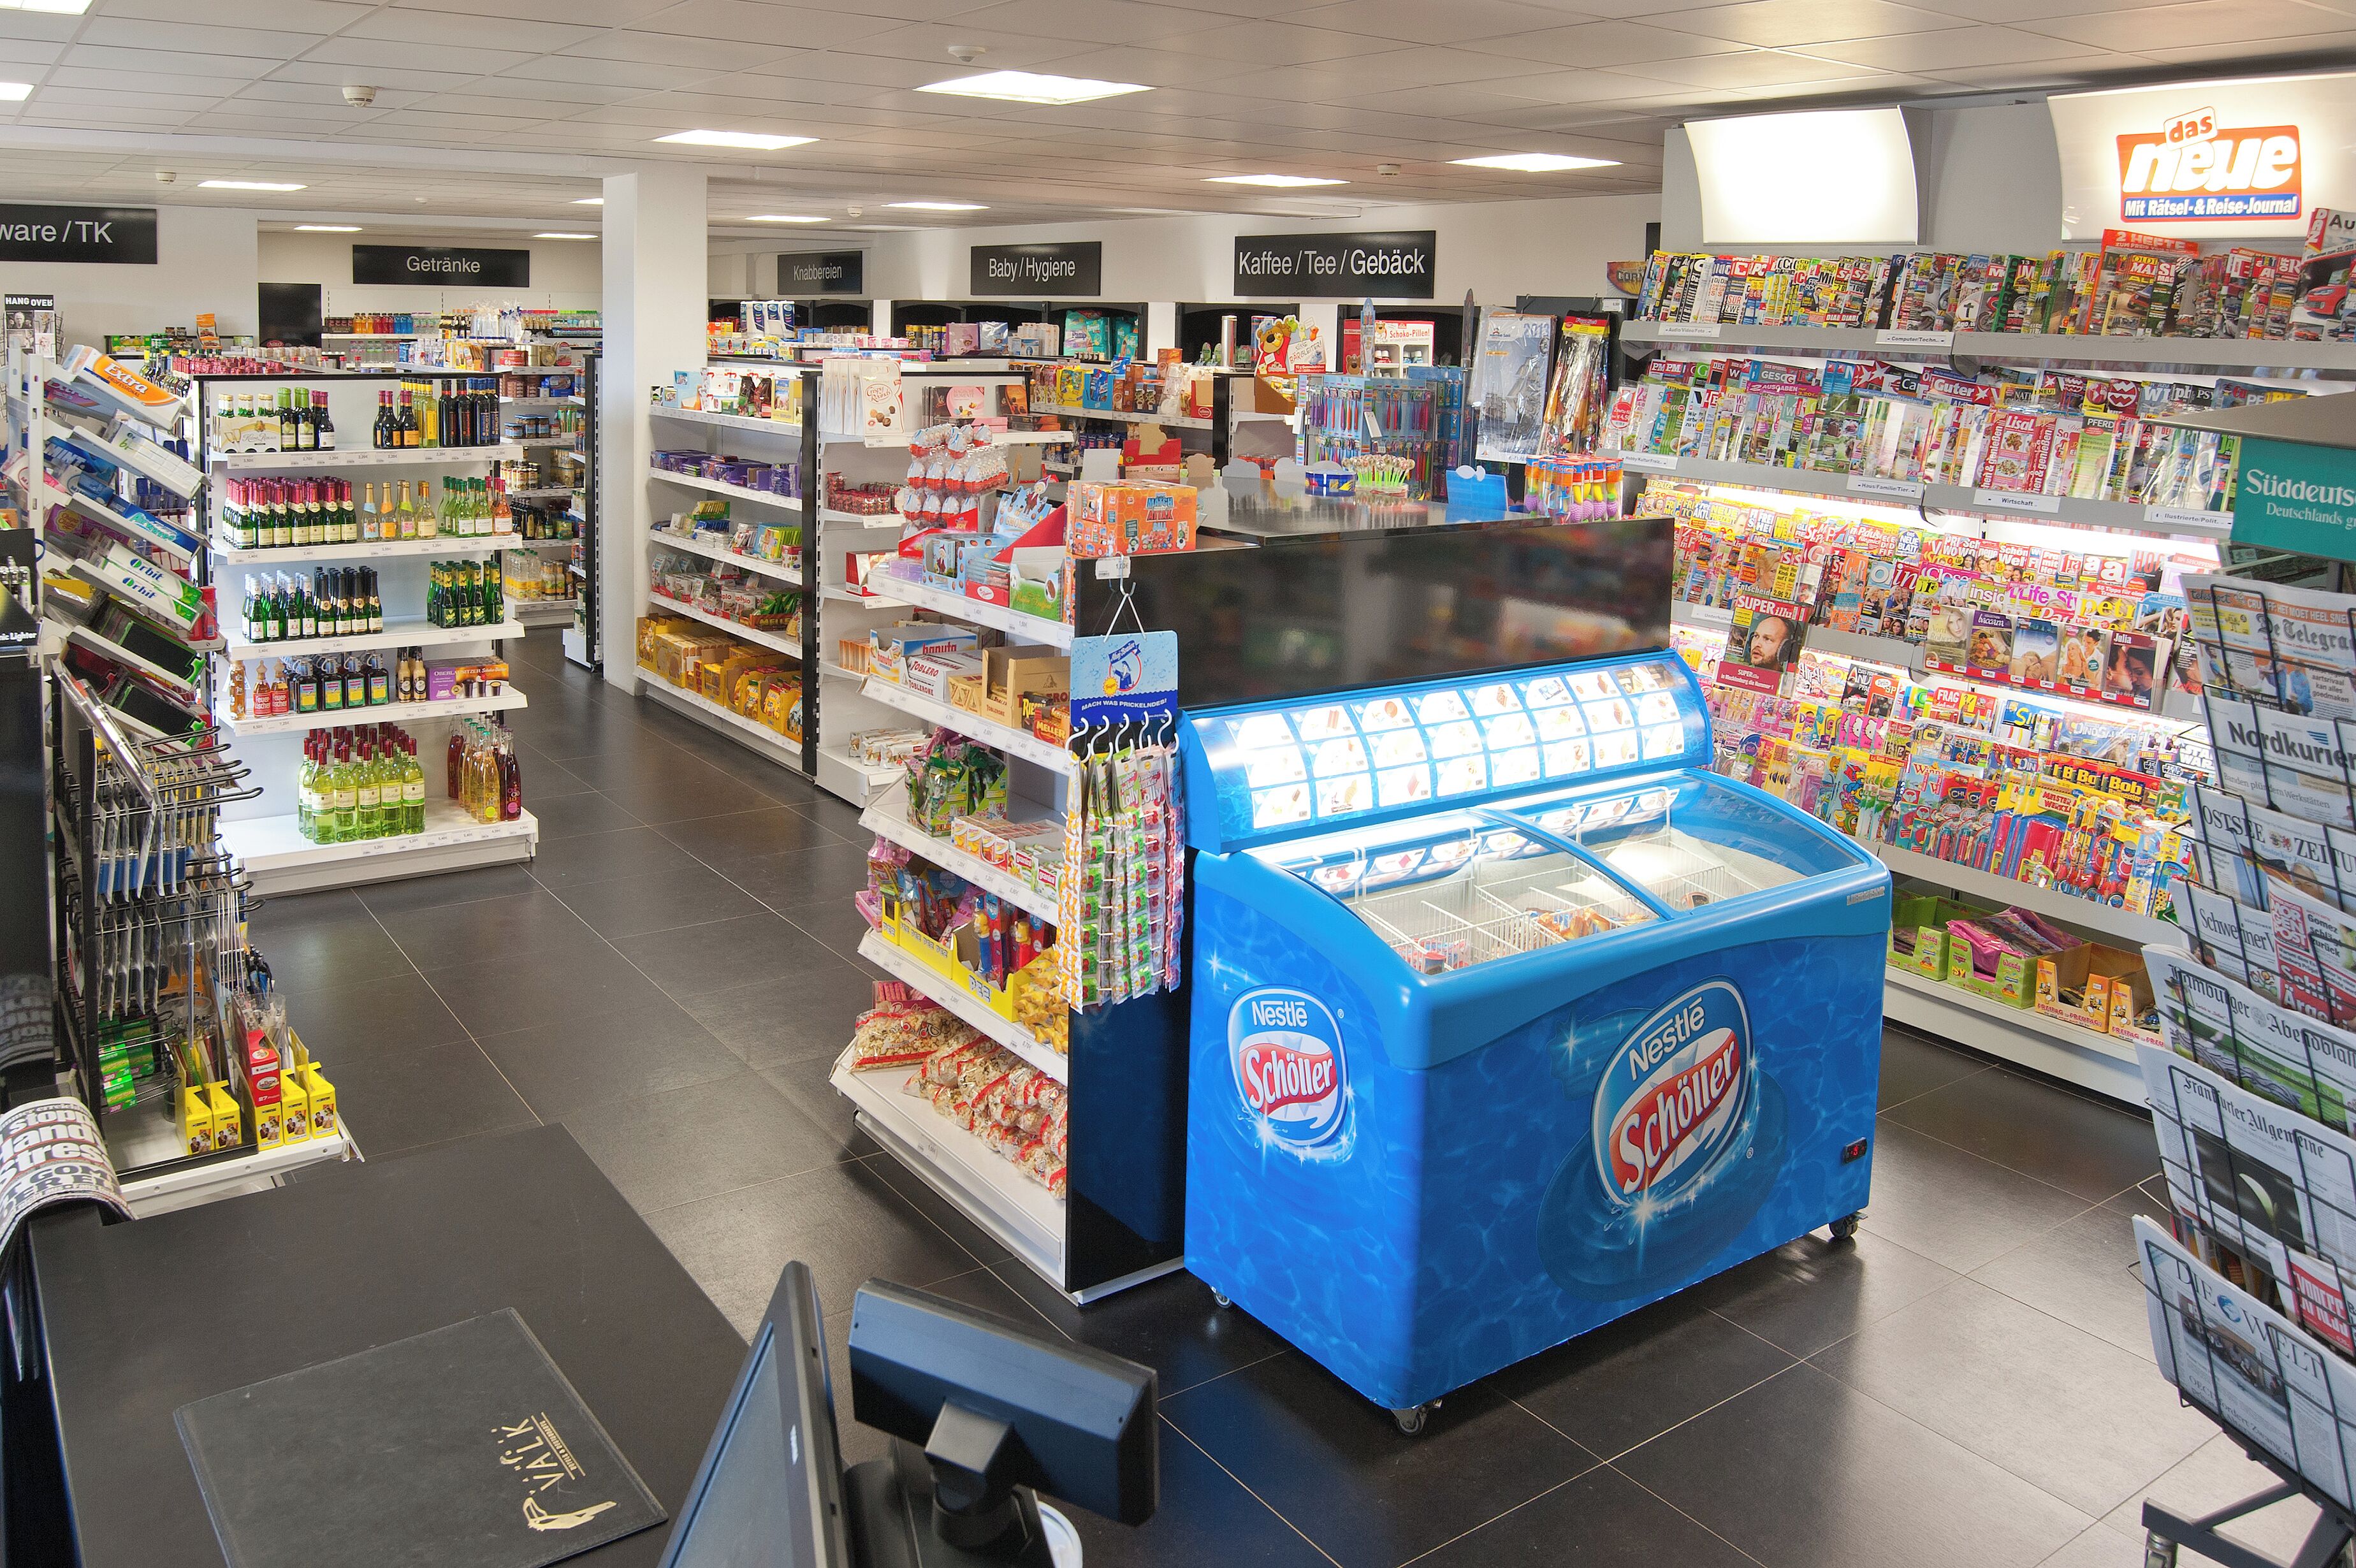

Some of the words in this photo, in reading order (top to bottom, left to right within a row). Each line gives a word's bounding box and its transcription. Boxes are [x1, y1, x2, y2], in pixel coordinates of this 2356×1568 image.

[2169, 115, 2212, 143] das
[2122, 136, 2297, 193] neue
[2125, 200, 2145, 216] Mit
[75, 221, 113, 243] TK
[2116, 231, 2130, 242] 2
[2134, 232, 2186, 250] HEFTE
[407, 256, 481, 273] Getränke
[794, 262, 842, 281] Knabbereien
[989, 258, 1017, 282] Baby
[1026, 256, 1075, 282] Hygiene
[1239, 250, 1293, 275] Kaffee
[1305, 250, 1336, 275] Tee
[1350, 247, 1425, 276] Gebäck
[1390, 328, 1430, 338] Schoko-Pillen!
[104, 363, 149, 395] Extra
[1934, 379, 1975, 398] Guter
[2244, 468, 2356, 509] Süddeuts
[1147, 497, 1174, 507] MATCH
[1710, 504, 1739, 516] NEUE
[2002, 497, 2033, 507] Wirtschaft
[2266, 502, 2343, 525] Deutschlands
[1898, 542, 1918, 554] BLATT
[1900, 535, 1918, 547] NEUE
[2000, 542, 2028, 557] Schön
[130, 558, 164, 581] Orbit
[1926, 567, 1972, 583] Close
[122, 576, 157, 600] Orbit
[1971, 586, 2007, 604] insid
[2019, 584, 2050, 604] Life
[1738, 594, 1793, 619] SUPERillu
[2081, 597, 2137, 620] petr
[2290, 606, 2309, 621] MOET
[2310, 611, 2329, 624] HEEL
[2113, 633, 2133, 644] Julia
[2282, 617, 2353, 651] Telegra
[922, 641, 957, 655] hanuta
[908, 680, 934, 697] TOBLERONE
[2311, 674, 2345, 686] aartsrivaal
[1937, 690, 1960, 703] FRAG
[2312, 690, 2350, 704] goedmaken
[2328, 686, 2343, 695] alles
[1081, 701, 1102, 711] MACH
[1119, 698, 1167, 708] PRICKELNDES!
[1036, 720, 1066, 737] MELLER
[2109, 775, 2142, 795] Bob
[2223, 772, 2250, 788] Banden
[2284, 789, 2331, 810] Werkstätten
[2202, 804, 2265, 845] OSTSEE
[2294, 837, 2356, 876] ZEITU
[2199, 908, 2267, 951] Schweiner
[2307, 913, 2339, 934] Gomez
[1251, 1000, 1308, 1027] Nestlé
[1629, 996, 1705, 1081] Nestlé
[1246, 1049, 1333, 1110] Schöller
[1618, 1040, 1735, 1195] Schöller
[2248, 1108, 2325, 1160] Allgemeine
[2178, 1258, 2217, 1308] DIE
[2238, 1307, 2322, 1381] WELT
[501, 1418, 565, 1492] VALK
